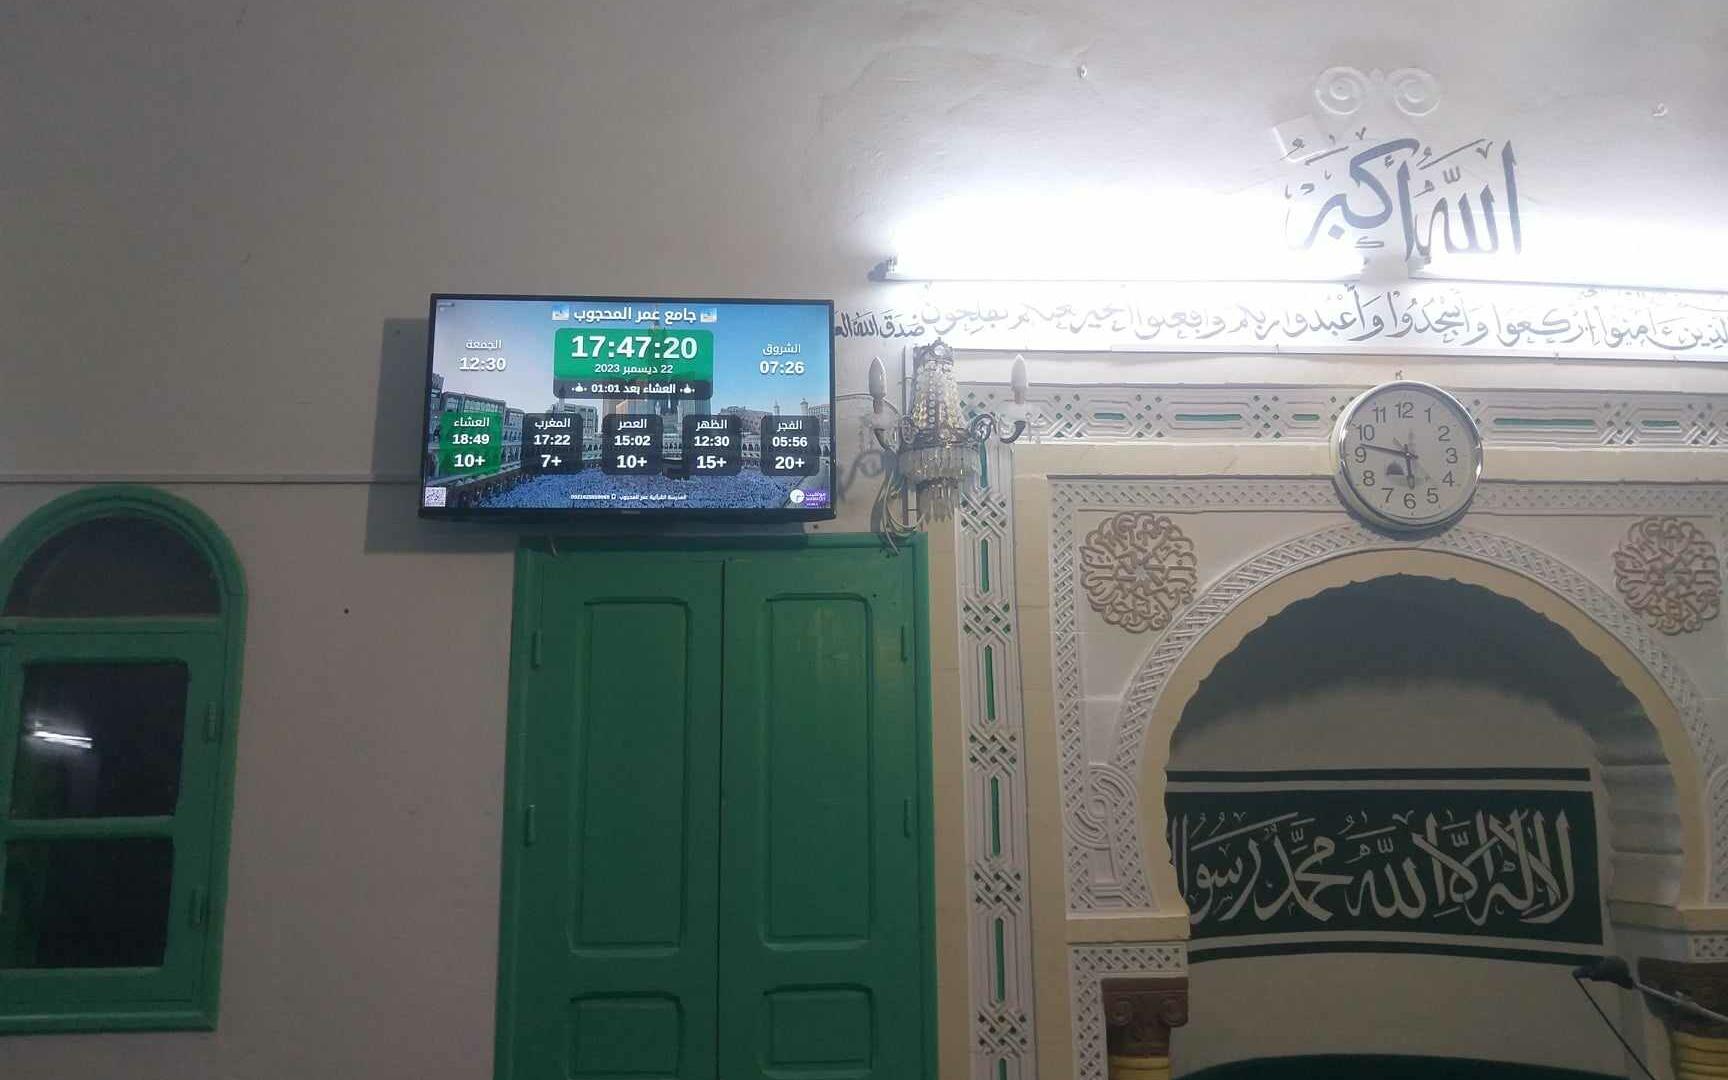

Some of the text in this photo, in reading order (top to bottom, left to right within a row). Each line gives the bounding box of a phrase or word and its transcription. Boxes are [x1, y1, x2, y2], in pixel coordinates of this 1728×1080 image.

[573, 306, 697, 324] جامع عمر المحجوب
[465, 338, 502, 349] الجمعة
[571, 335, 698, 359] 17:47:20
[762, 342, 801, 356] الشروق
[459, 357, 506, 371] 12:30
[595, 364, 673, 375] 22 ديسمبر 2023
[759, 361, 805, 375] 07:26
[591, 383, 676, 395] العشاء بعد 01:01
[1374, 406, 1386, 423] 11
[1395, 402, 1414, 419] 12
[1424, 408, 1432, 423] 1
[453, 417, 491, 428] العشاء
[534, 418, 571, 430] المغرب
[617, 418, 648, 430] العصر
[695, 418, 728, 430] الظهر
[776, 419, 803, 432] الفجر
[452, 434, 490, 445] 18:49
[1358, 424, 1375, 441] 10
[1438, 426, 1450, 442] 2
[533, 434, 571, 446] 17:22
[614, 434, 651, 447] 15:02
[694, 435, 730, 447] 12:30
[772, 435, 808, 447] 05:56
[1355, 447, 1367, 463] 9
[1446, 447, 1458, 464] 3
[1363, 470, 1375, 486] 8
[1442, 471, 1455, 487] 4
[1382, 488, 1394, 503] 7
[1404, 493, 1416, 509] 6
[1427, 488, 1439, 504] 5
